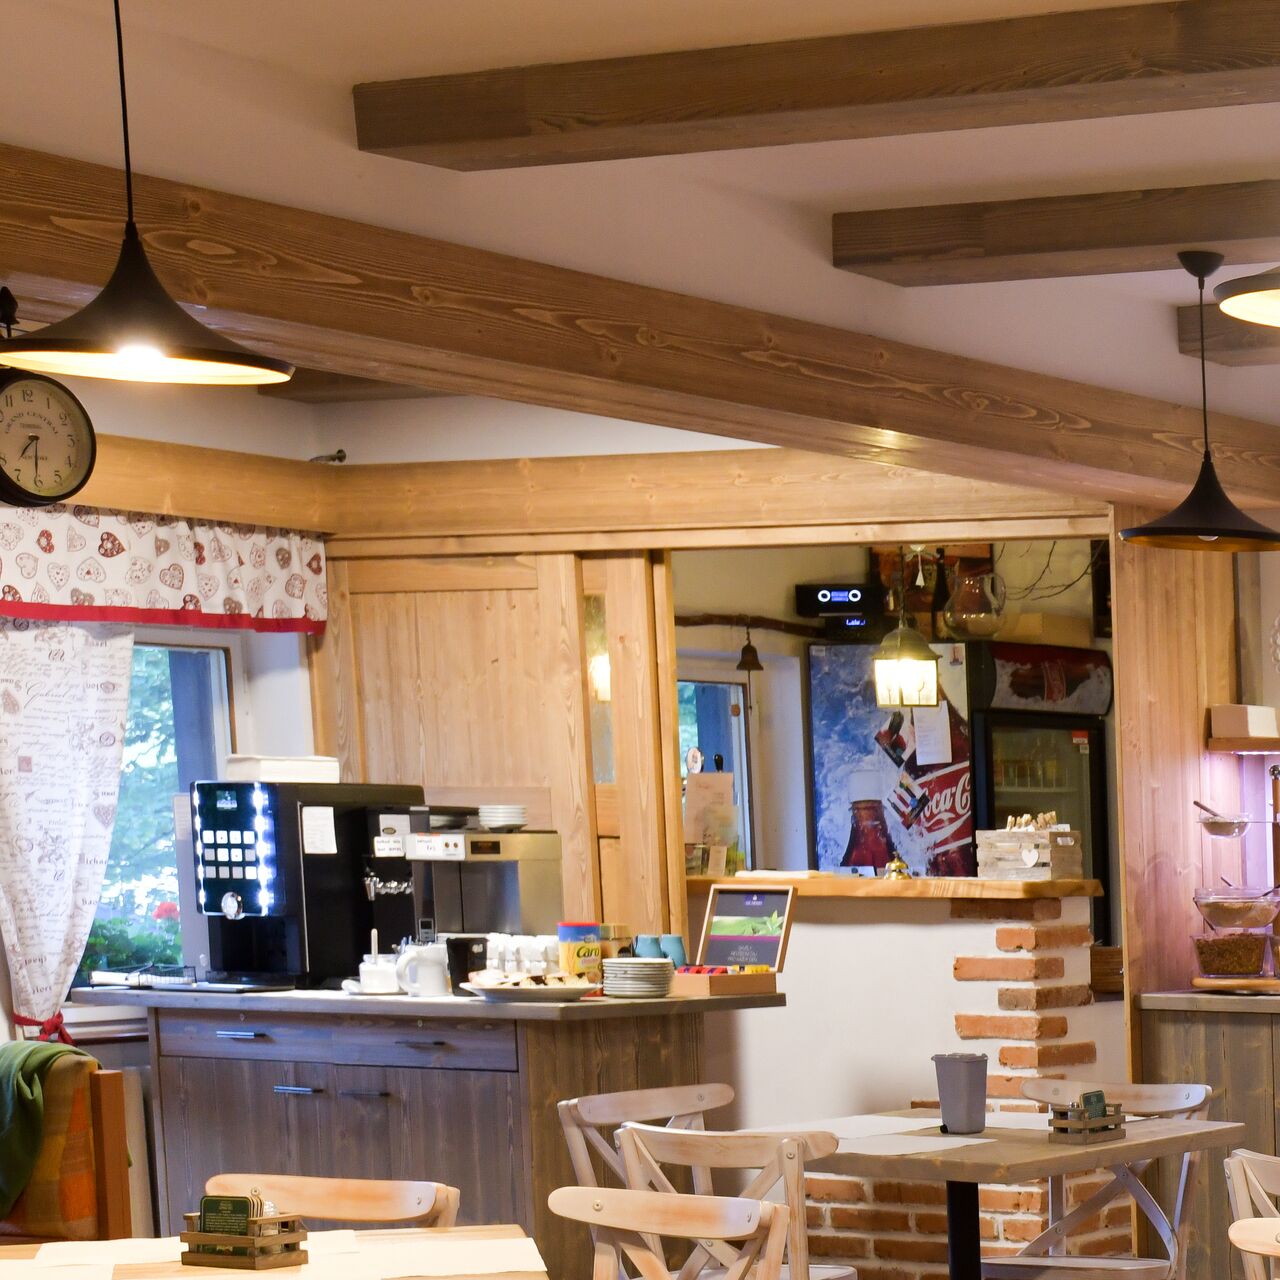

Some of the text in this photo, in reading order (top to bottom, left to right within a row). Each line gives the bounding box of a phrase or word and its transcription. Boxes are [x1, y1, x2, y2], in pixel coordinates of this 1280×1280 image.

[5, 394, 13, 408] 11
[22, 389, 33, 402] 12
[14, 468, 21, 482] 7
[34, 474, 43, 488] 6
[54, 470, 63, 485] 5
[576, 944, 600, 958] Caro
